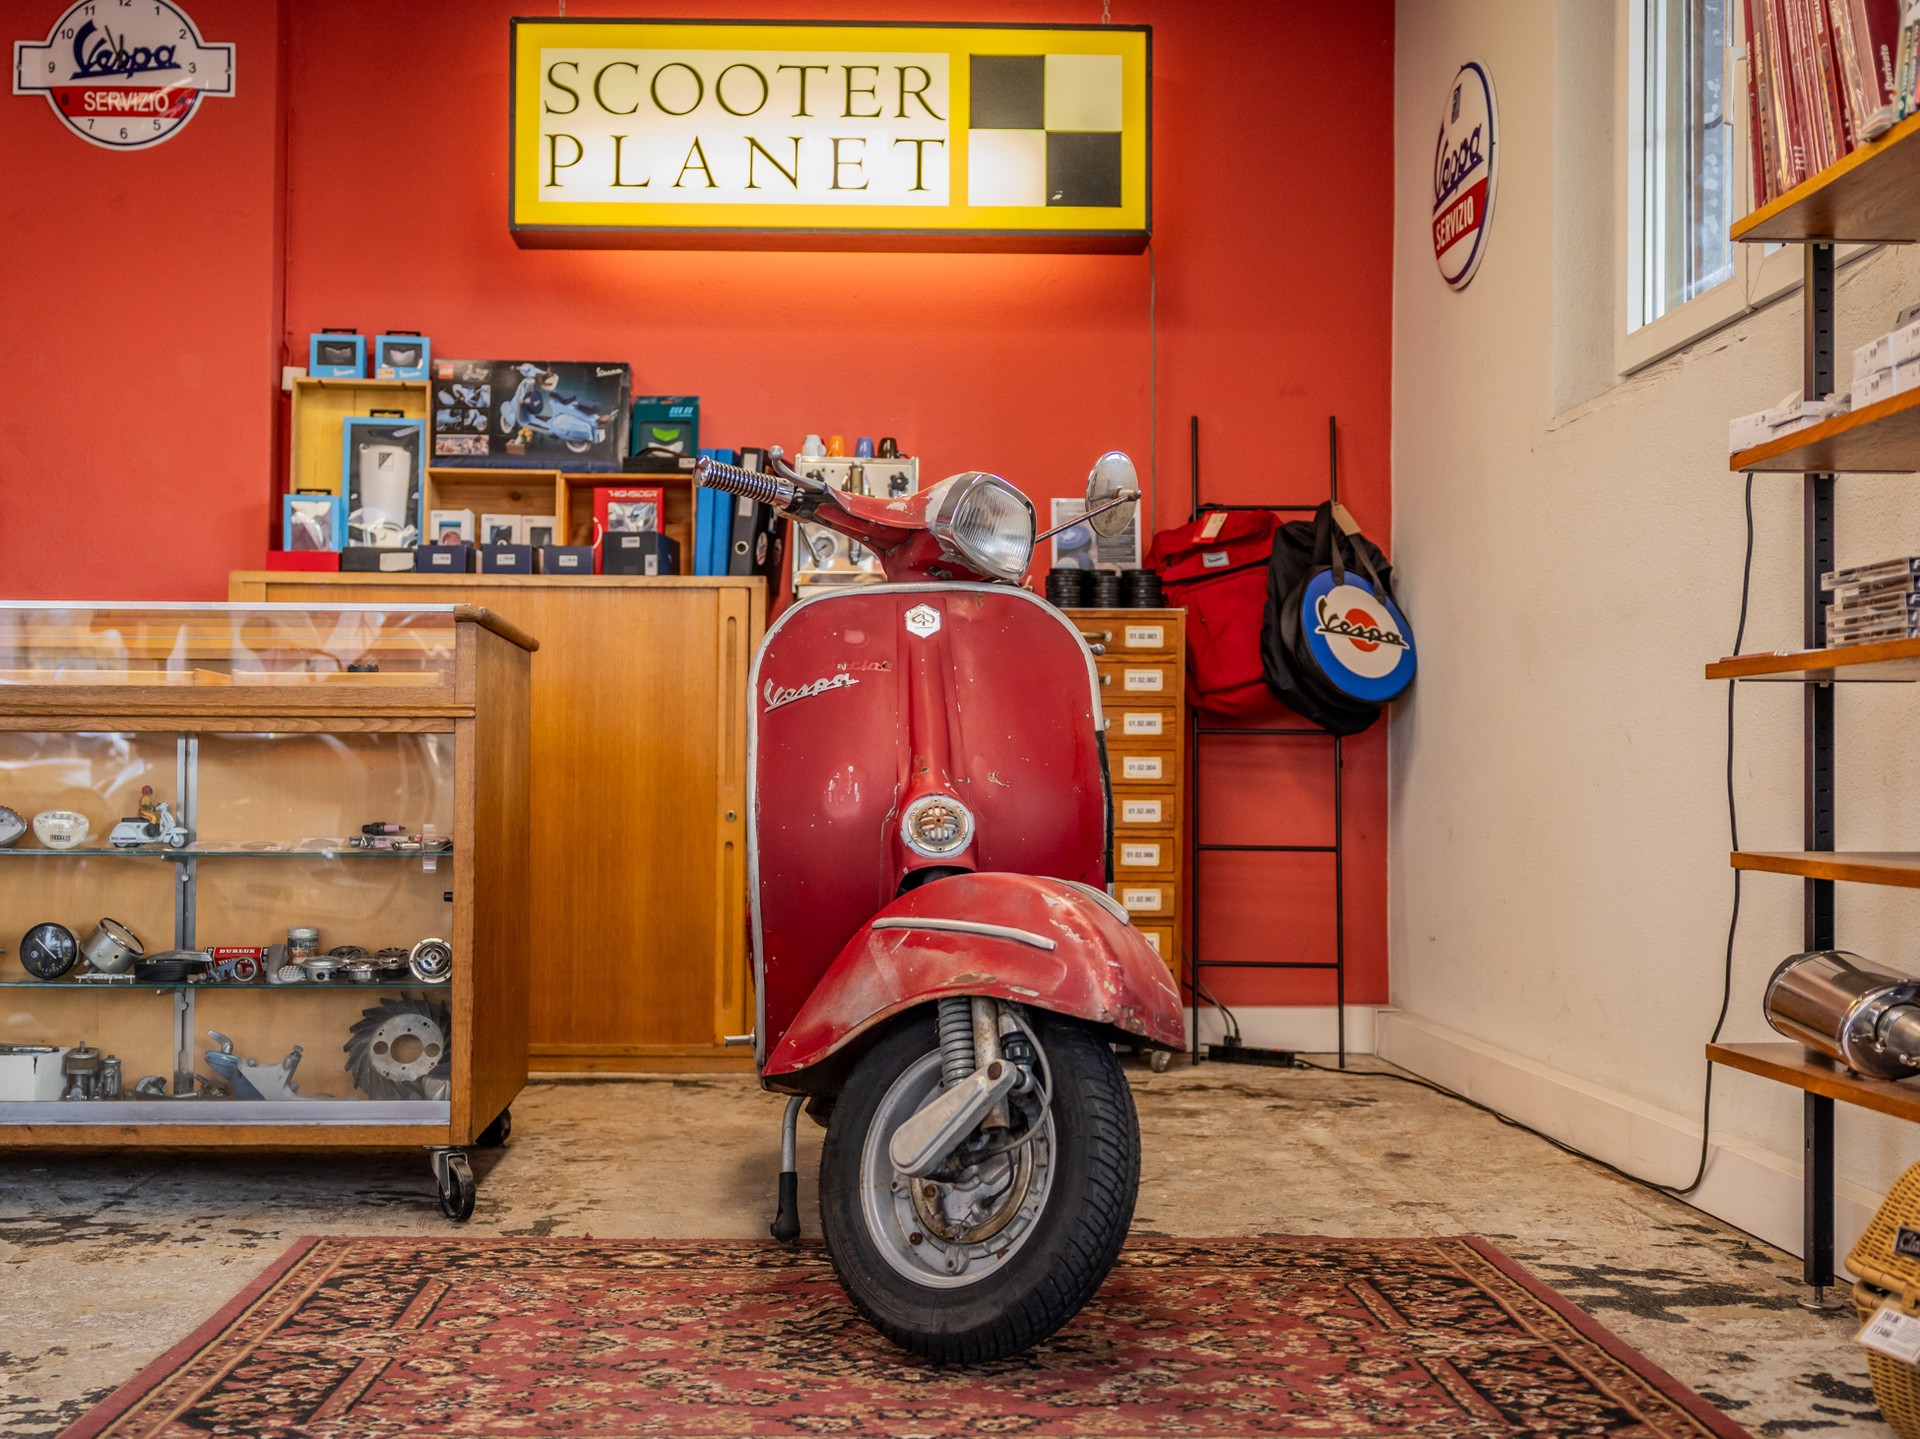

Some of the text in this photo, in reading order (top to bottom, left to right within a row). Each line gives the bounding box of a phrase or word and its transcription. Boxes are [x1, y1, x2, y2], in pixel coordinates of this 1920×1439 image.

[84, 6, 96, 16] 11
[155, 6, 161, 15] 1
[61, 29, 74, 39] 10
[179, 29, 187, 40] 2
[70, 19, 182, 80] Vespa
[48, 62, 55, 73] 9
[188, 63, 196, 73] 3
[544, 61, 947, 121] SCOOTER
[84, 91, 169, 112] SERVIZIO
[88, 119, 95, 130] 7
[153, 119, 161, 131] 5
[120, 128, 128, 139] 6
[544, 133, 947, 192] PLANET
[1433, 121, 1484, 217] Vespa
[1436, 195, 1475, 251] SERVIZIO
[1317, 597, 1409, 648] Vespa
[764, 673, 859, 713] Vespa
